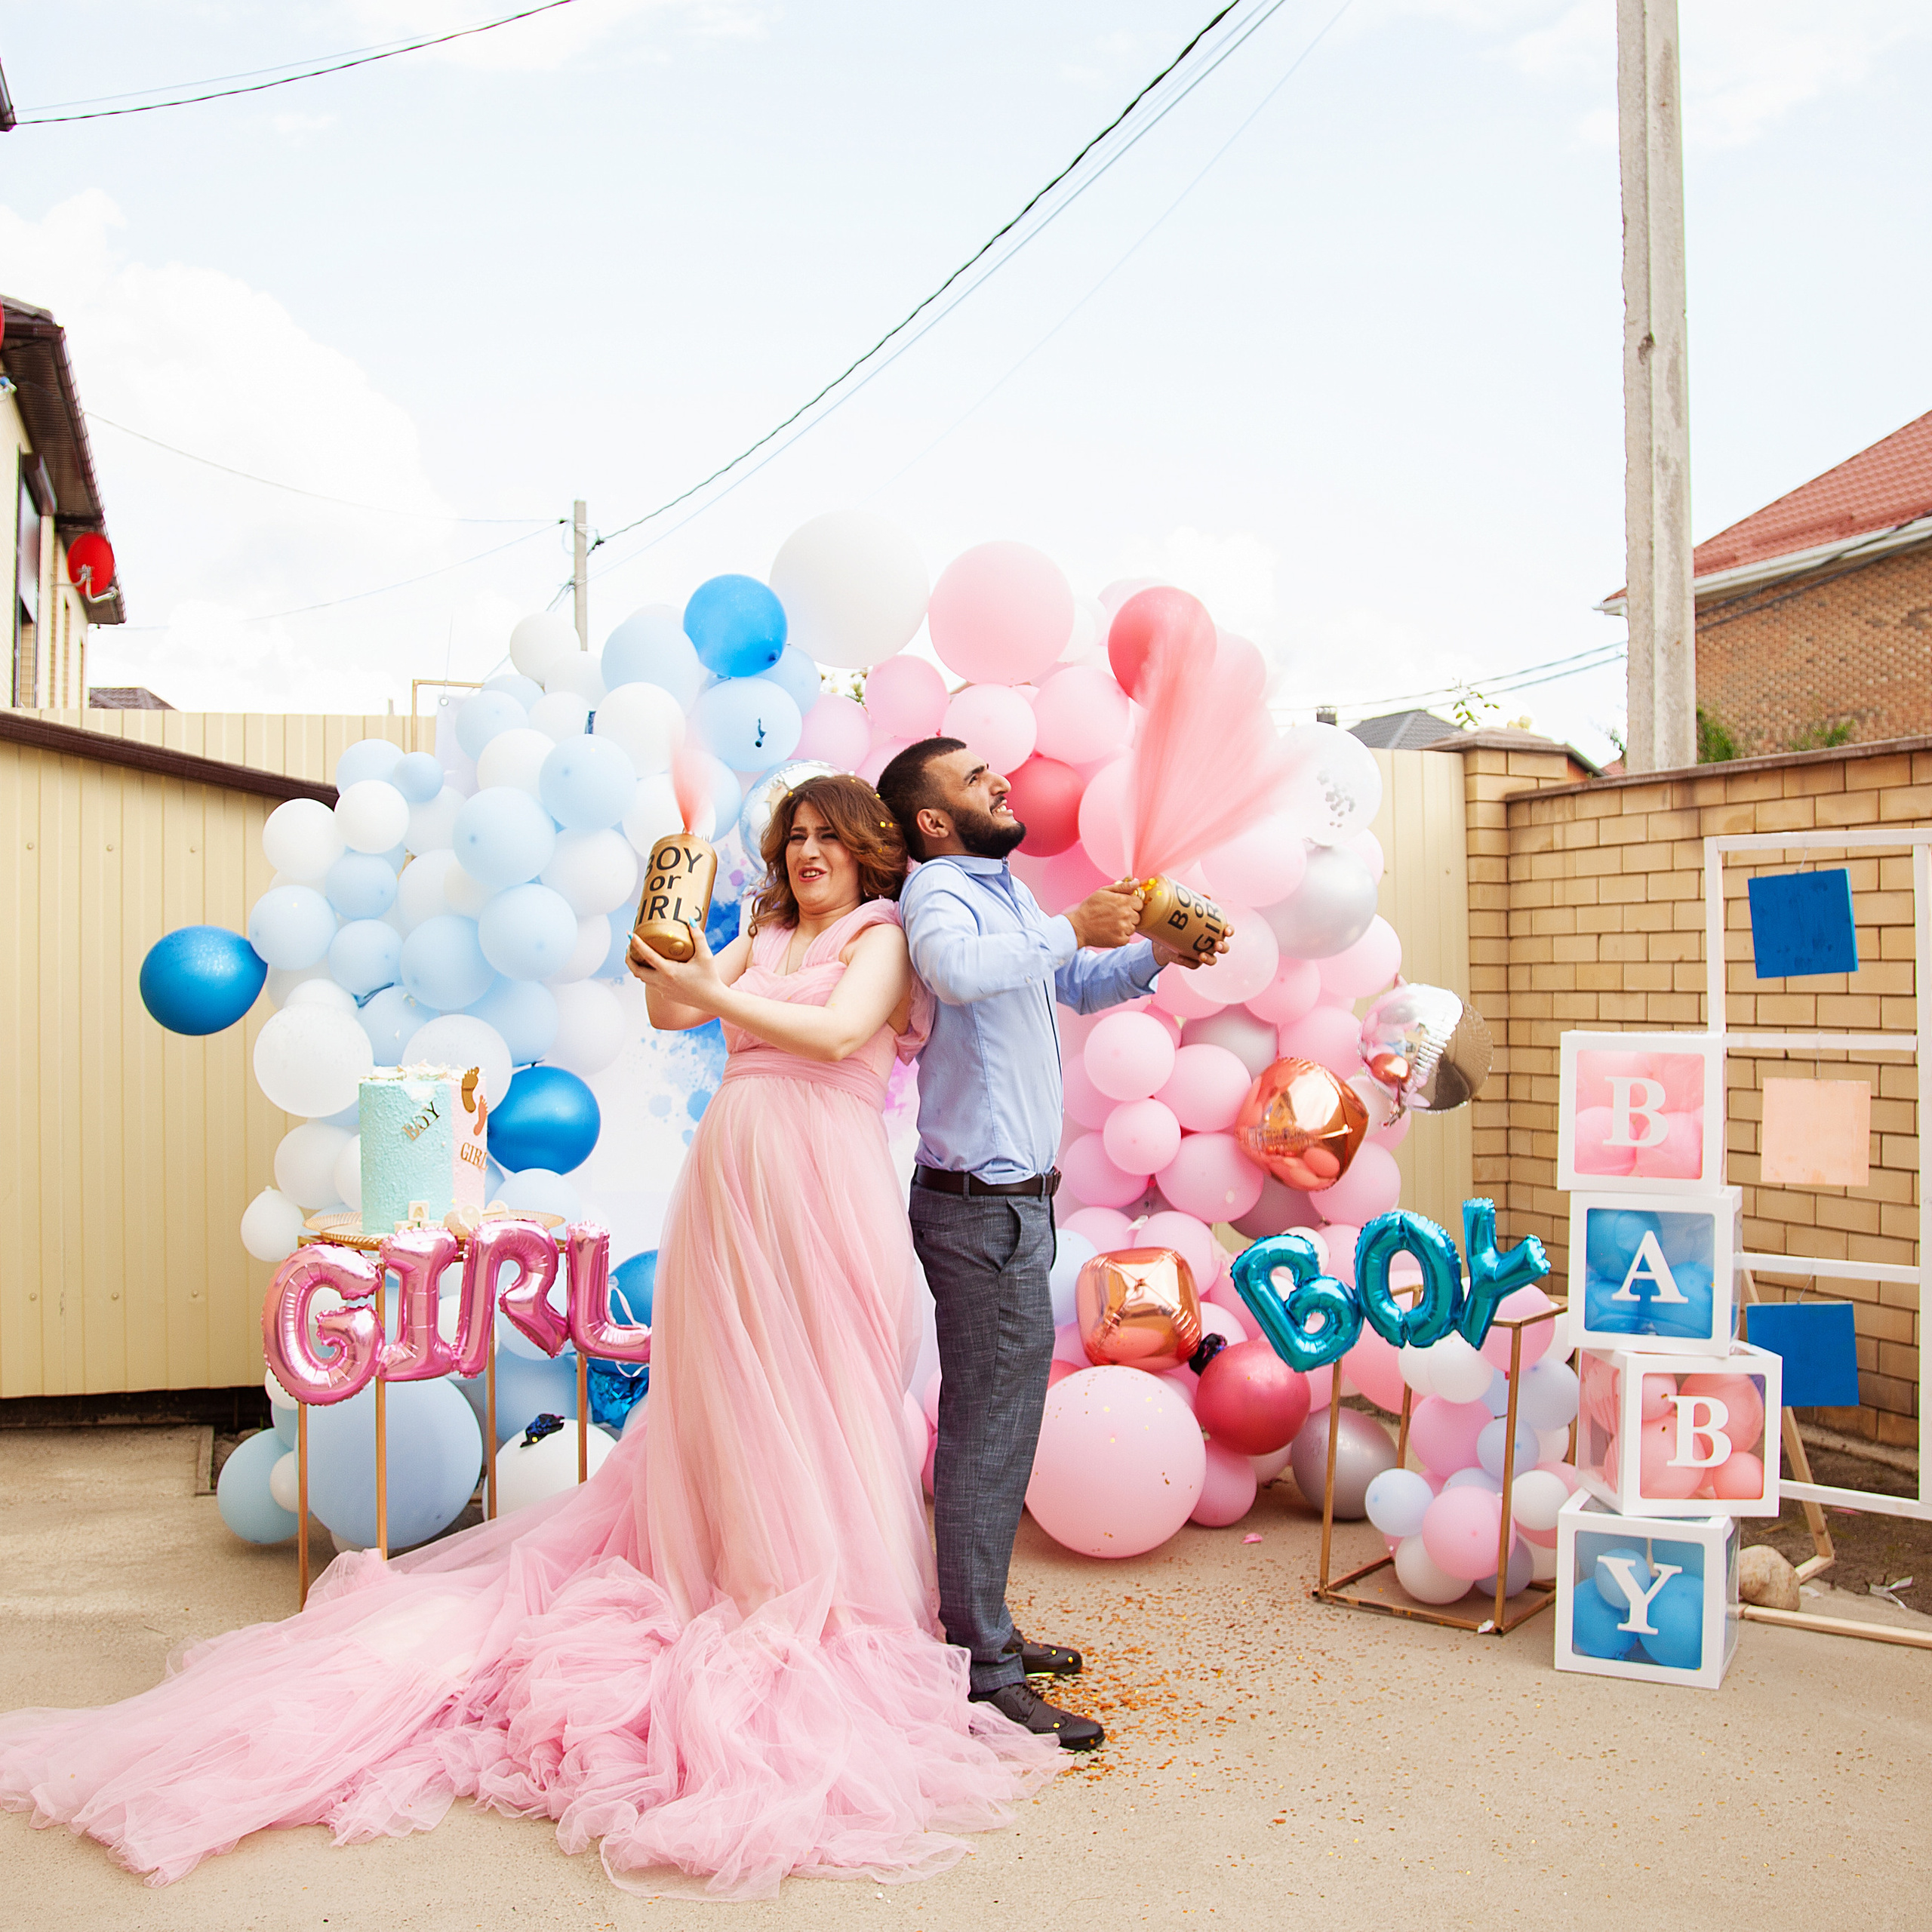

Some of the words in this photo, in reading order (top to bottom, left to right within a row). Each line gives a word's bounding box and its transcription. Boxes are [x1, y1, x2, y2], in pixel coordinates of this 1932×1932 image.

[649, 875, 681, 891] or
[1168, 885, 1192, 931] BO
[1192, 902, 1222, 952] GIR
[402, 1101, 440, 1141] BOY
[460, 1142, 488, 1171] GIRL
[1231, 1197, 1551, 1373] BOY
[261, 1218, 651, 1405] GIRL
